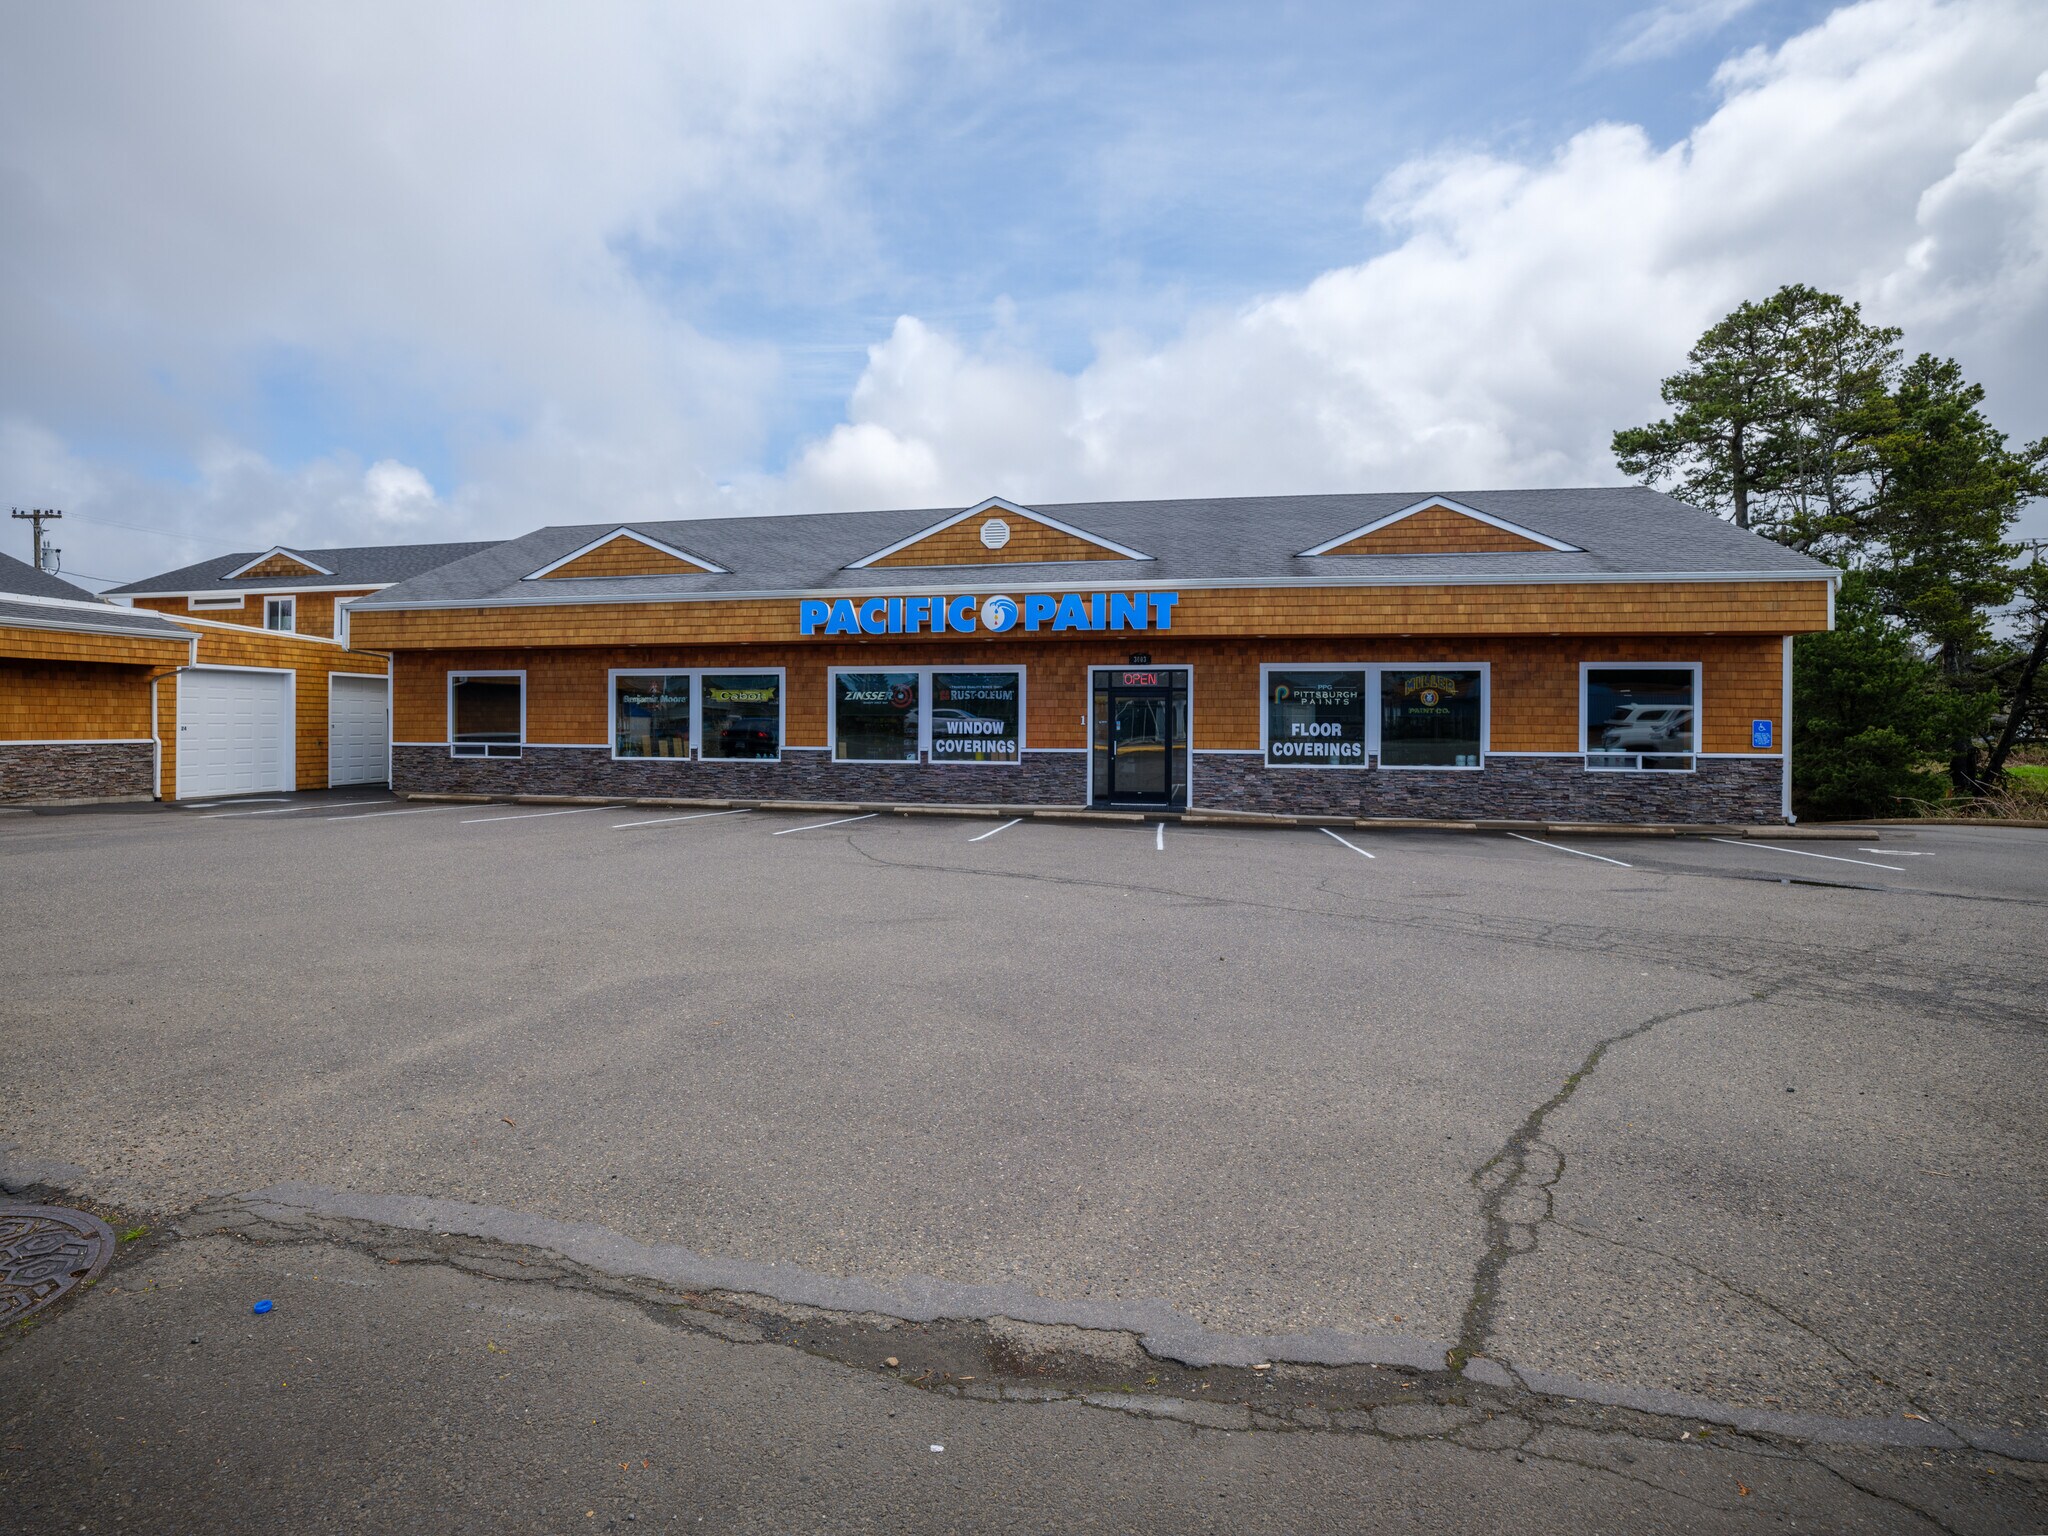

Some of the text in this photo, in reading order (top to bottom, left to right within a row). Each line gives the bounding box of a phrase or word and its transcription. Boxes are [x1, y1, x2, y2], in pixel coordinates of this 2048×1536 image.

[799, 592, 1179, 635] PACIFIC PAINT
[1124, 673, 1157, 685] OPEN
[1404, 675, 1456, 696] MILLER
[660, 694, 686, 703] Moore
[844, 691, 894, 701] ZINSSER
[950, 690, 1013, 701] RUST-OLEUM
[1080, 715, 1086, 726] 1
[946, 721, 1005, 735] WINDOW
[1291, 722, 1342, 737] FLOOR
[935, 739, 1016, 754] COVERINGS
[1272, 742, 1362, 757] COVERINGS
